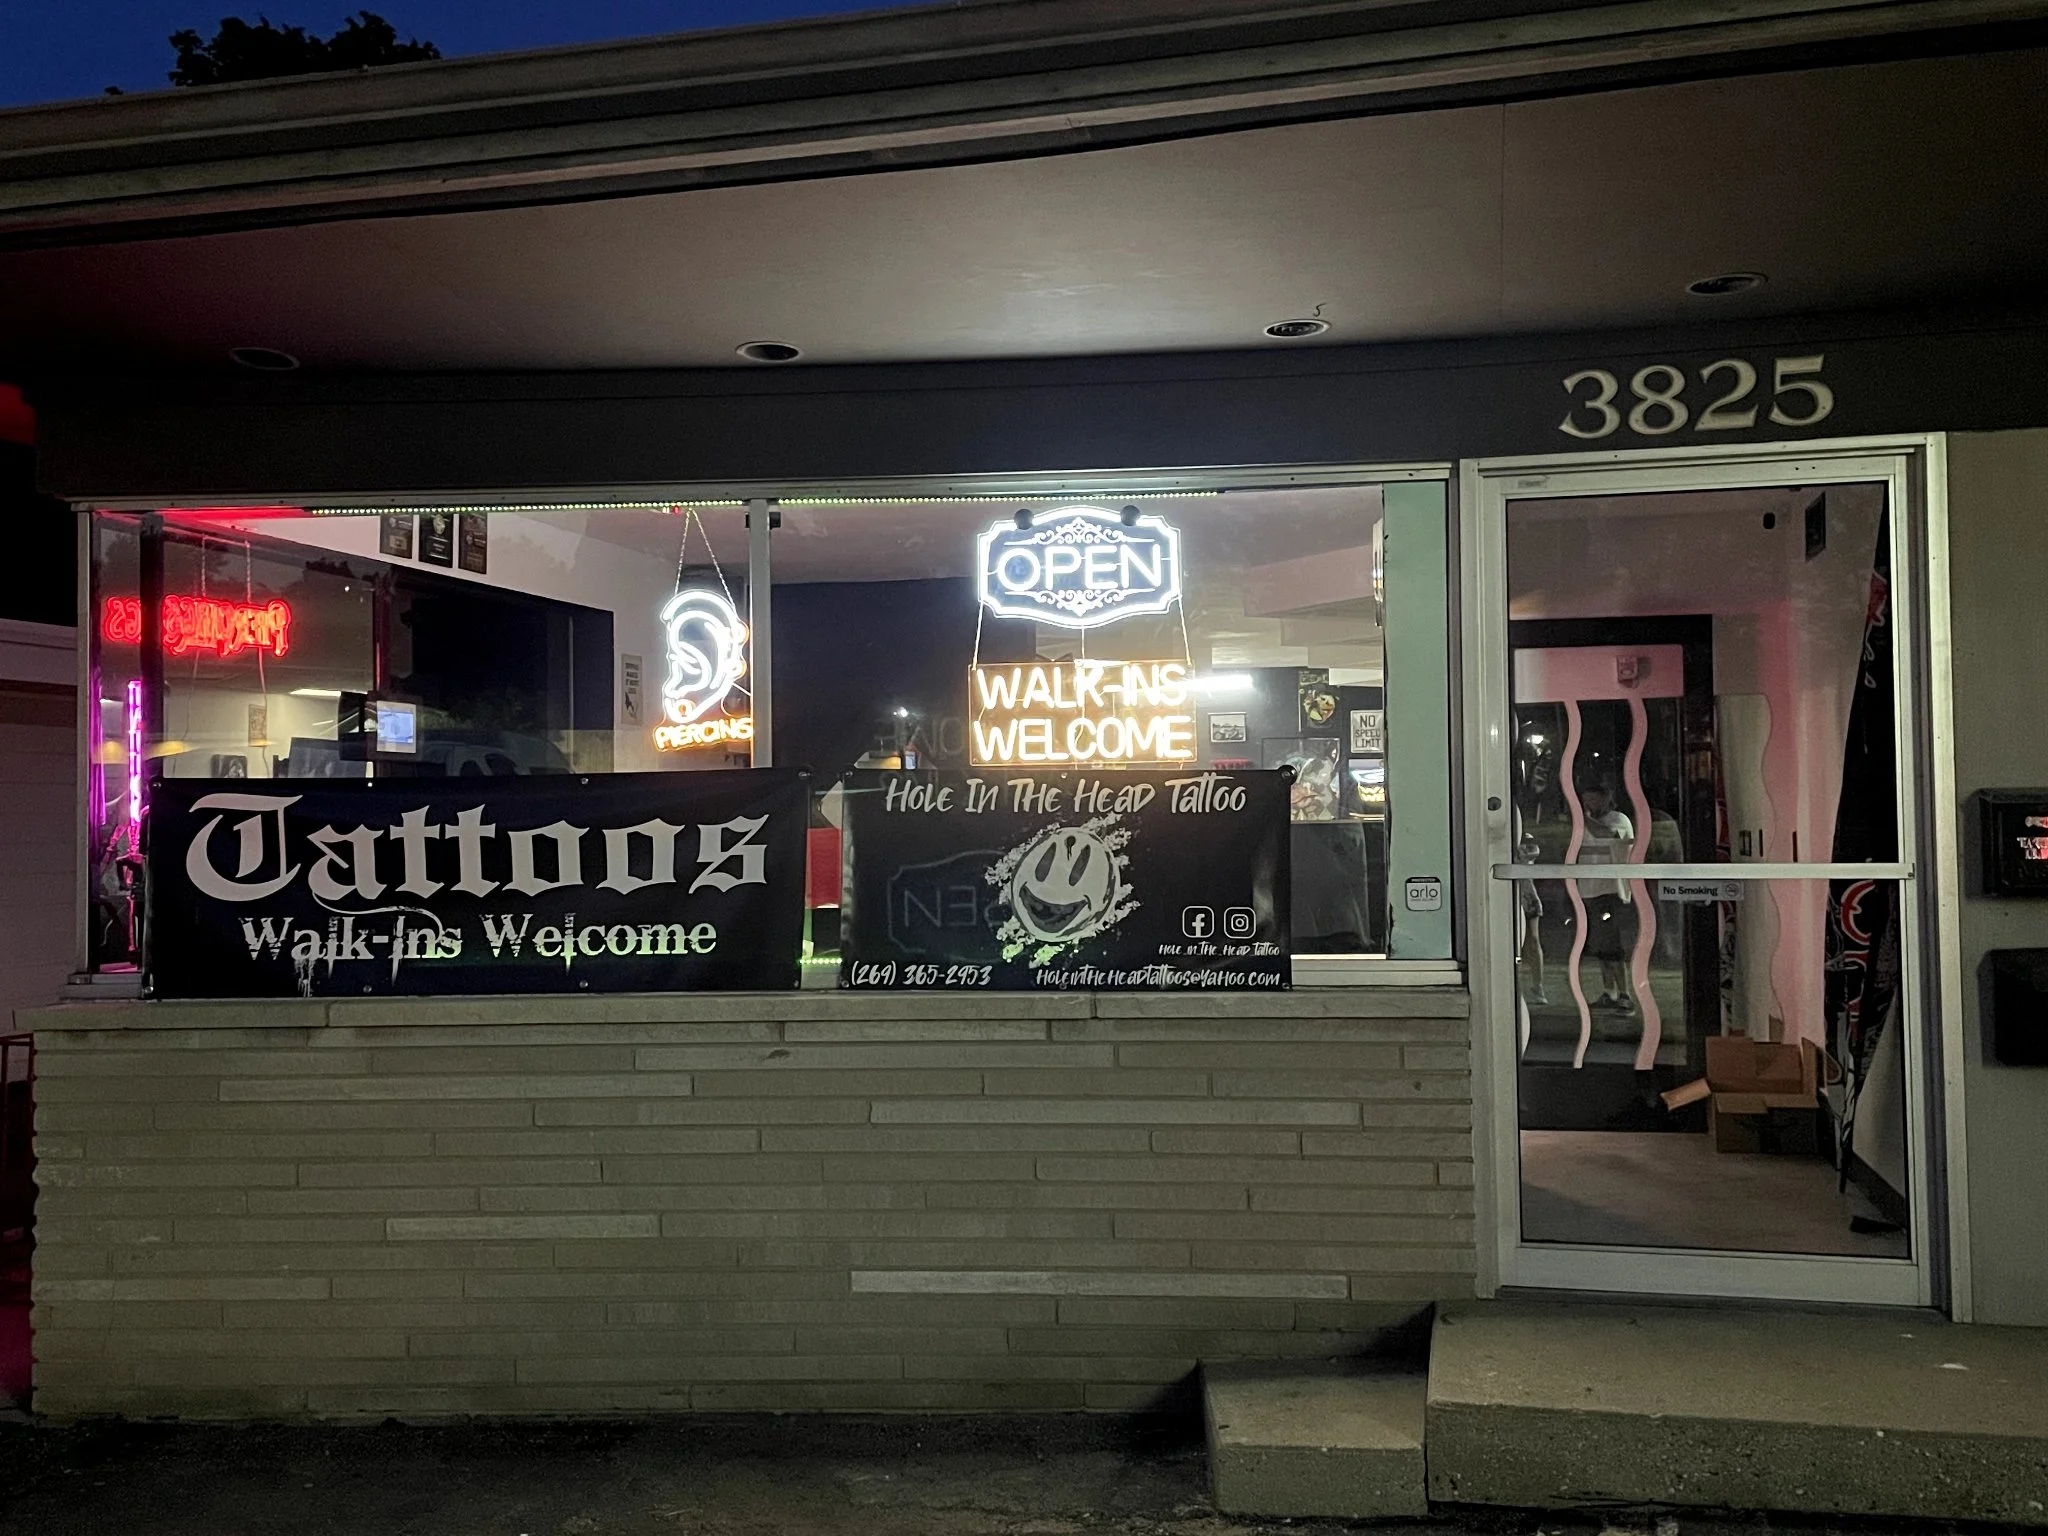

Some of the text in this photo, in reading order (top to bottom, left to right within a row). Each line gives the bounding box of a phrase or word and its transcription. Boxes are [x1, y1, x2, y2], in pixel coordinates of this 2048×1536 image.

[1558, 354, 1834, 439] 3825
[997, 544, 1162, 593] OPEN
[977, 663, 1187, 710] WALK-INS
[973, 716, 1193, 762] WELCOME
[1355, 729, 1381, 738] SPEED
[1360, 714, 1376, 728] NO
[1355, 739, 1381, 748] LIMIT
[1164, 772, 1246, 814] Tattoo
[186, 792, 770, 901] Tattoos
[1410, 885, 1438, 898] arlo
[1663, 885, 1718, 897] No Smoking
[240, 912, 717, 982] Walk-Ins Welcome
[851, 960, 993, 986] (269) 365-2953
